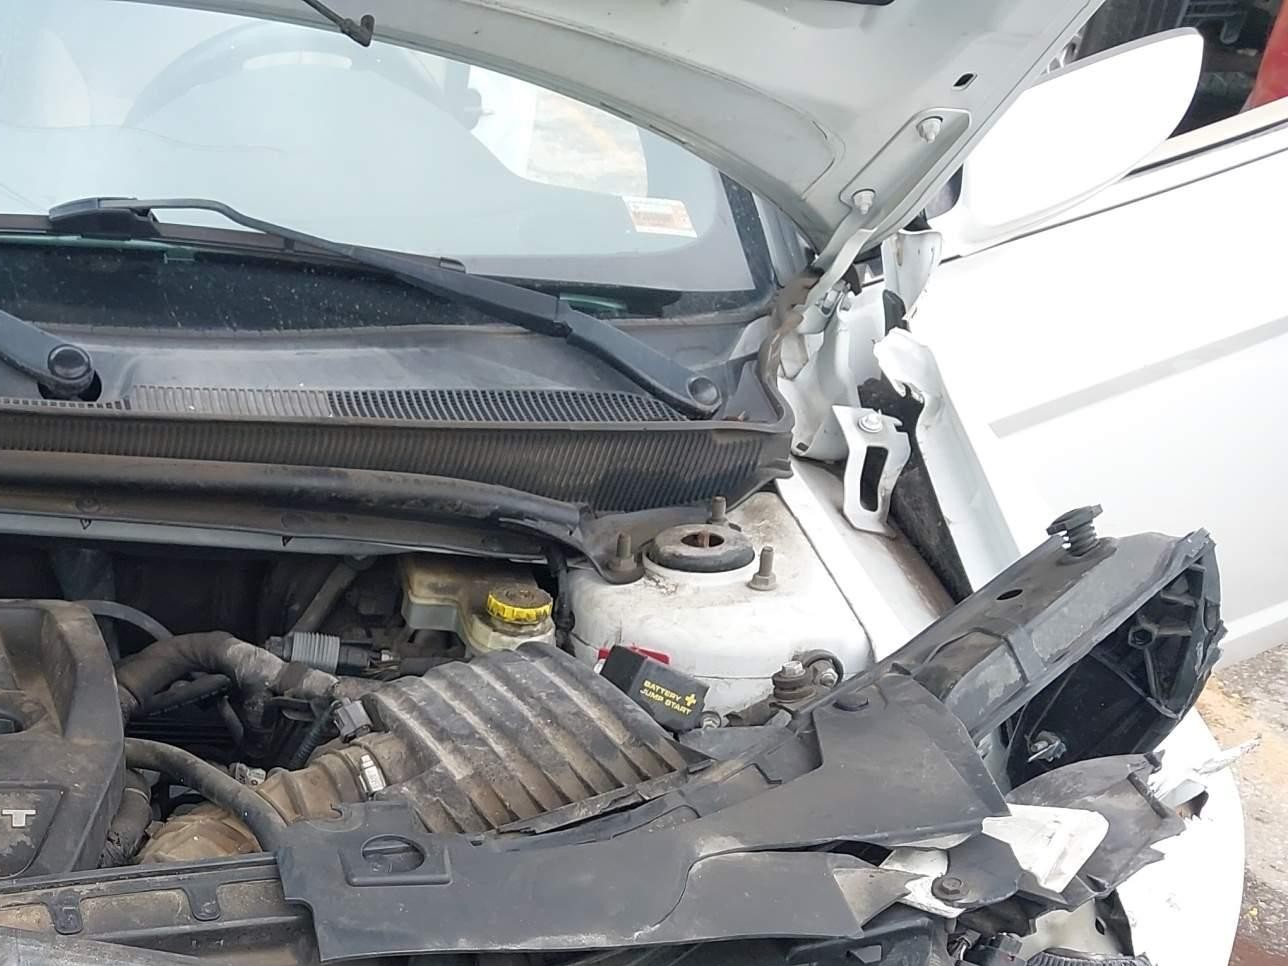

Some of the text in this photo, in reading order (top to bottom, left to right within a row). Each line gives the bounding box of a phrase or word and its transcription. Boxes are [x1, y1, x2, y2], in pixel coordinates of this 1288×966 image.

[640, 688, 693, 716] JUMP START
[643, 680, 682, 702] BATTERY
